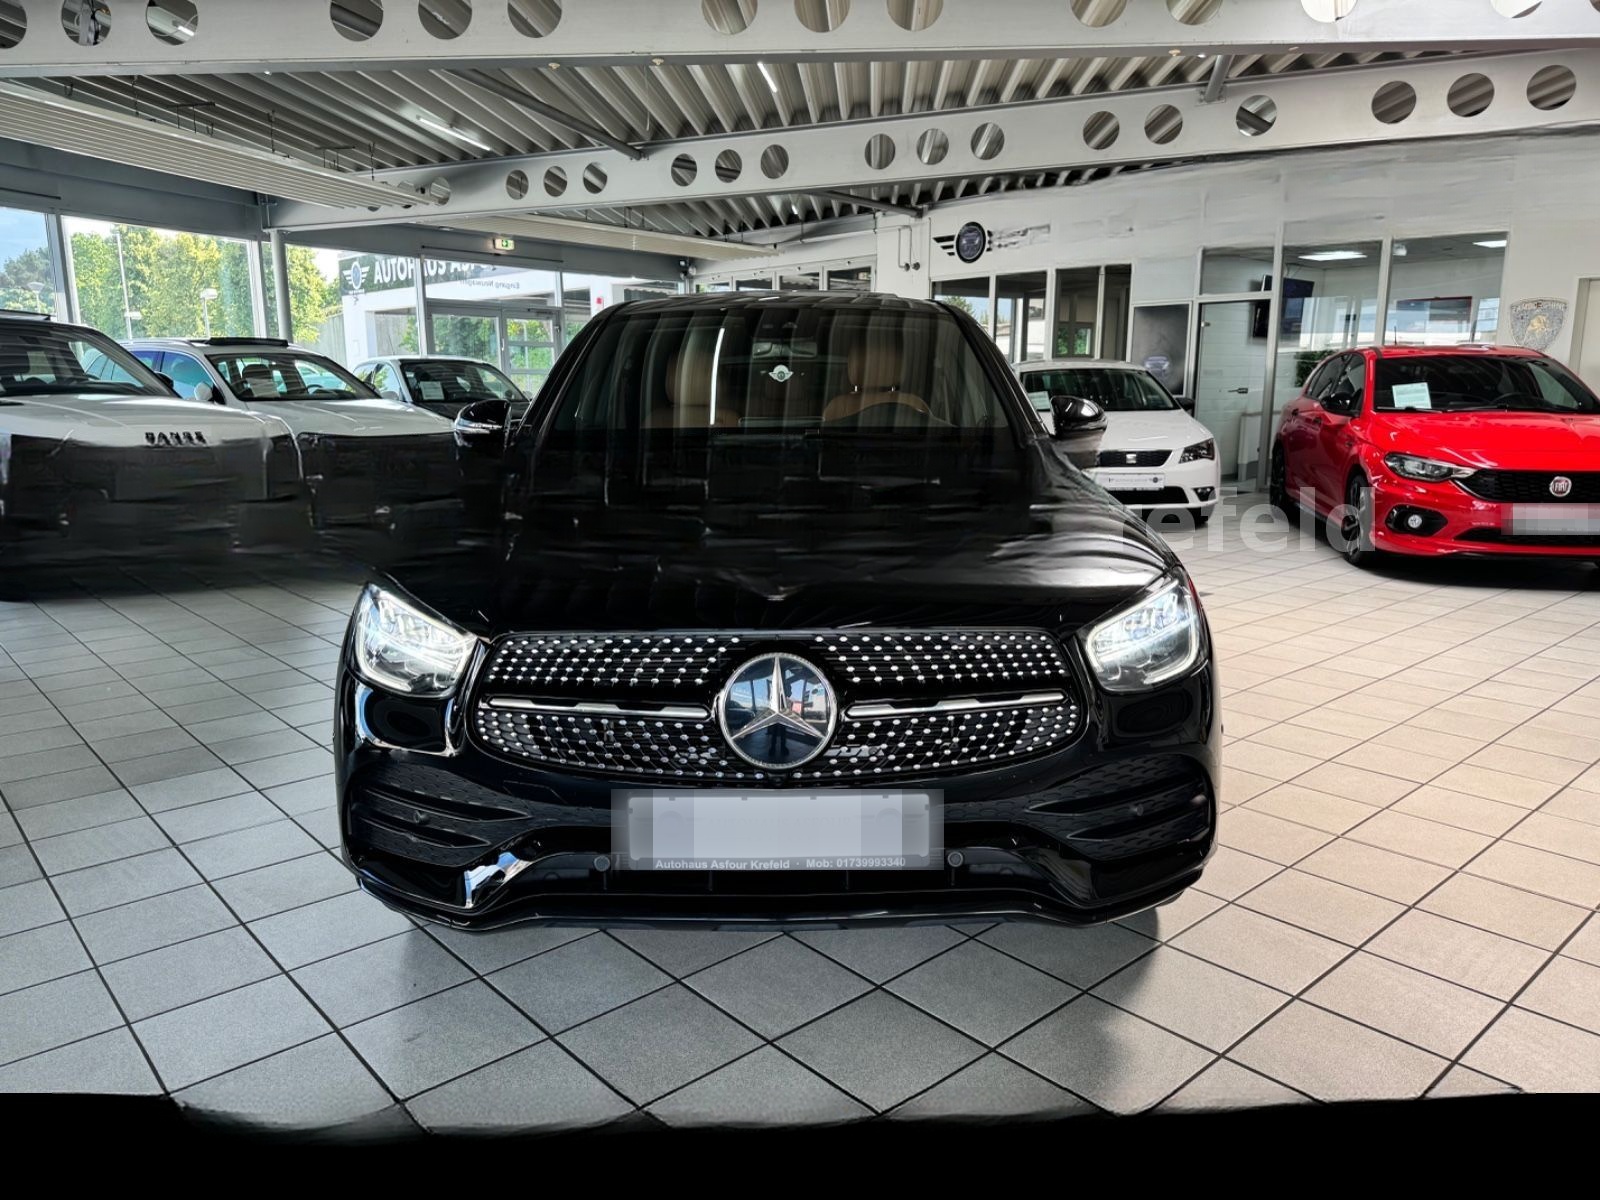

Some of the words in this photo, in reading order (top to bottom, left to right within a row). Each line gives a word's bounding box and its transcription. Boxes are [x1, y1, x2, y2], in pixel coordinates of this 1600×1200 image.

[655, 858, 708, 869] Autohaus
[710, 858, 748, 870] Asfour
[750, 858, 790, 870] Krefeld
[806, 858, 833, 868] Mob:
[836, 857, 906, 868] 01739993340
